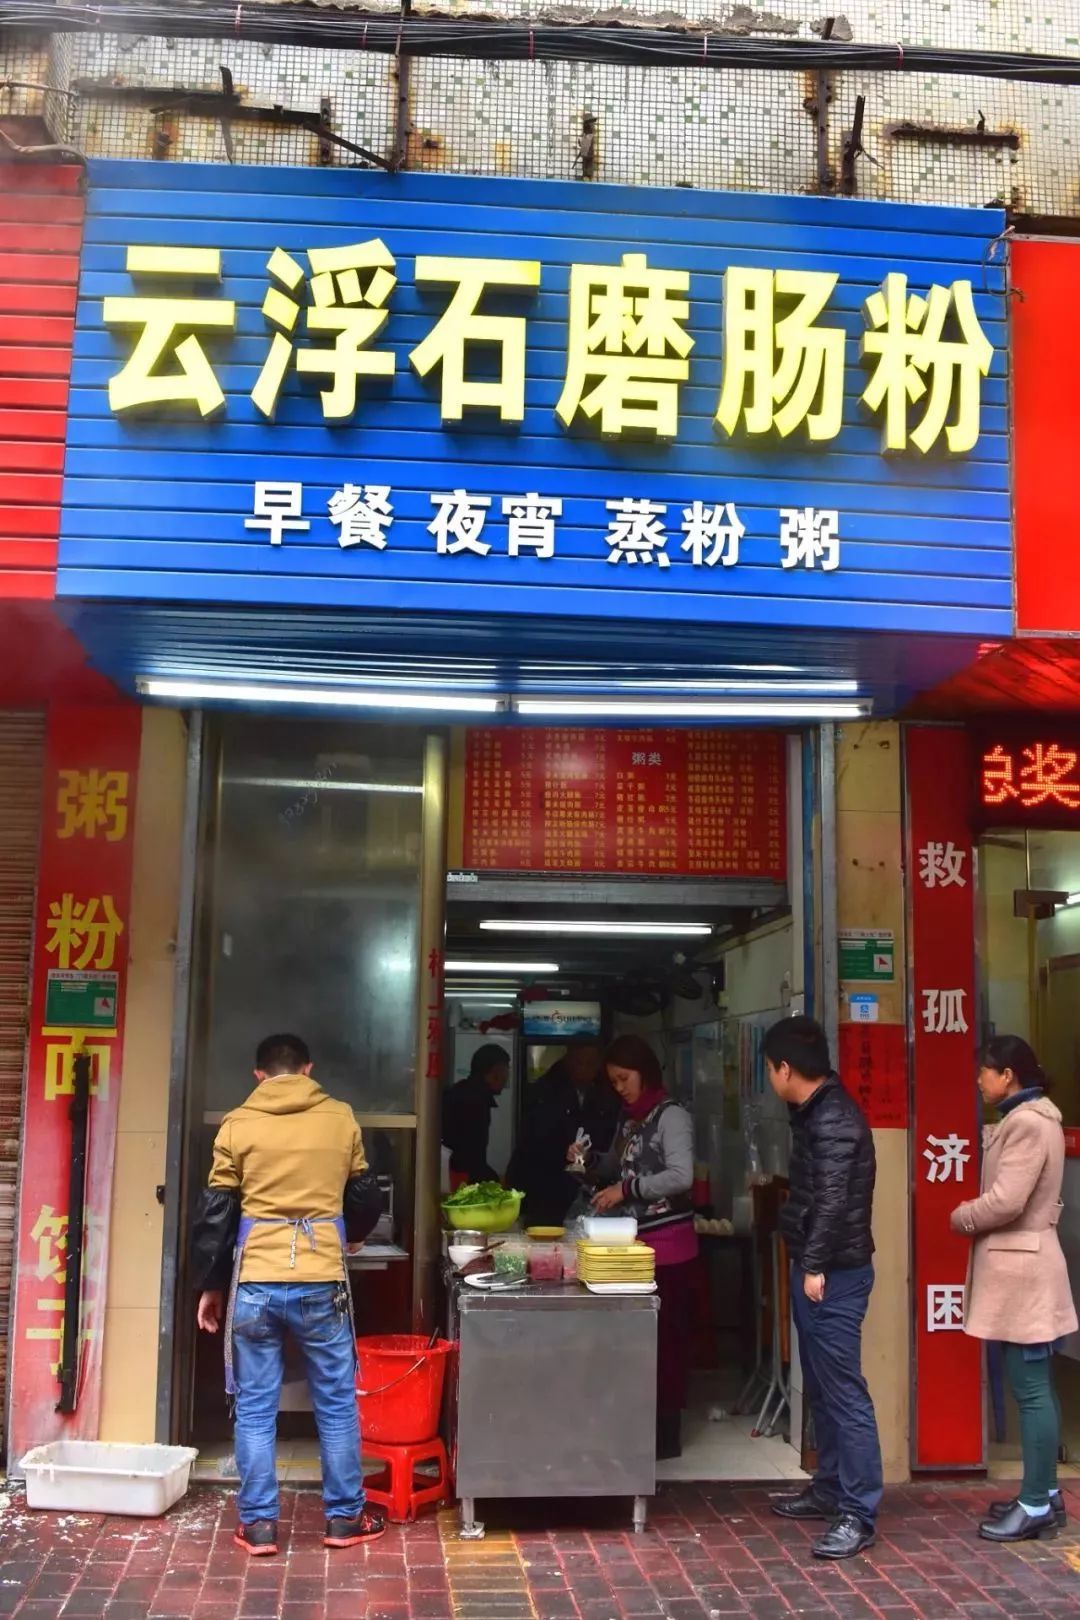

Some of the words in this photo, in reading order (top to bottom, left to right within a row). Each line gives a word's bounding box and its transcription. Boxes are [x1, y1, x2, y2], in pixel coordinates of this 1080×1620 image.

[102, 238, 994, 455] 云浮石磨肠粉
[244, 481, 394, 551] 早餐
[426, 489, 563, 558] 夜宵
[605, 497, 746, 567] 蒸粉
[779, 507, 841, 571] 粥
[632, 752, 663, 766] 粥类
[919, 842, 971, 1333] 救孤济困
